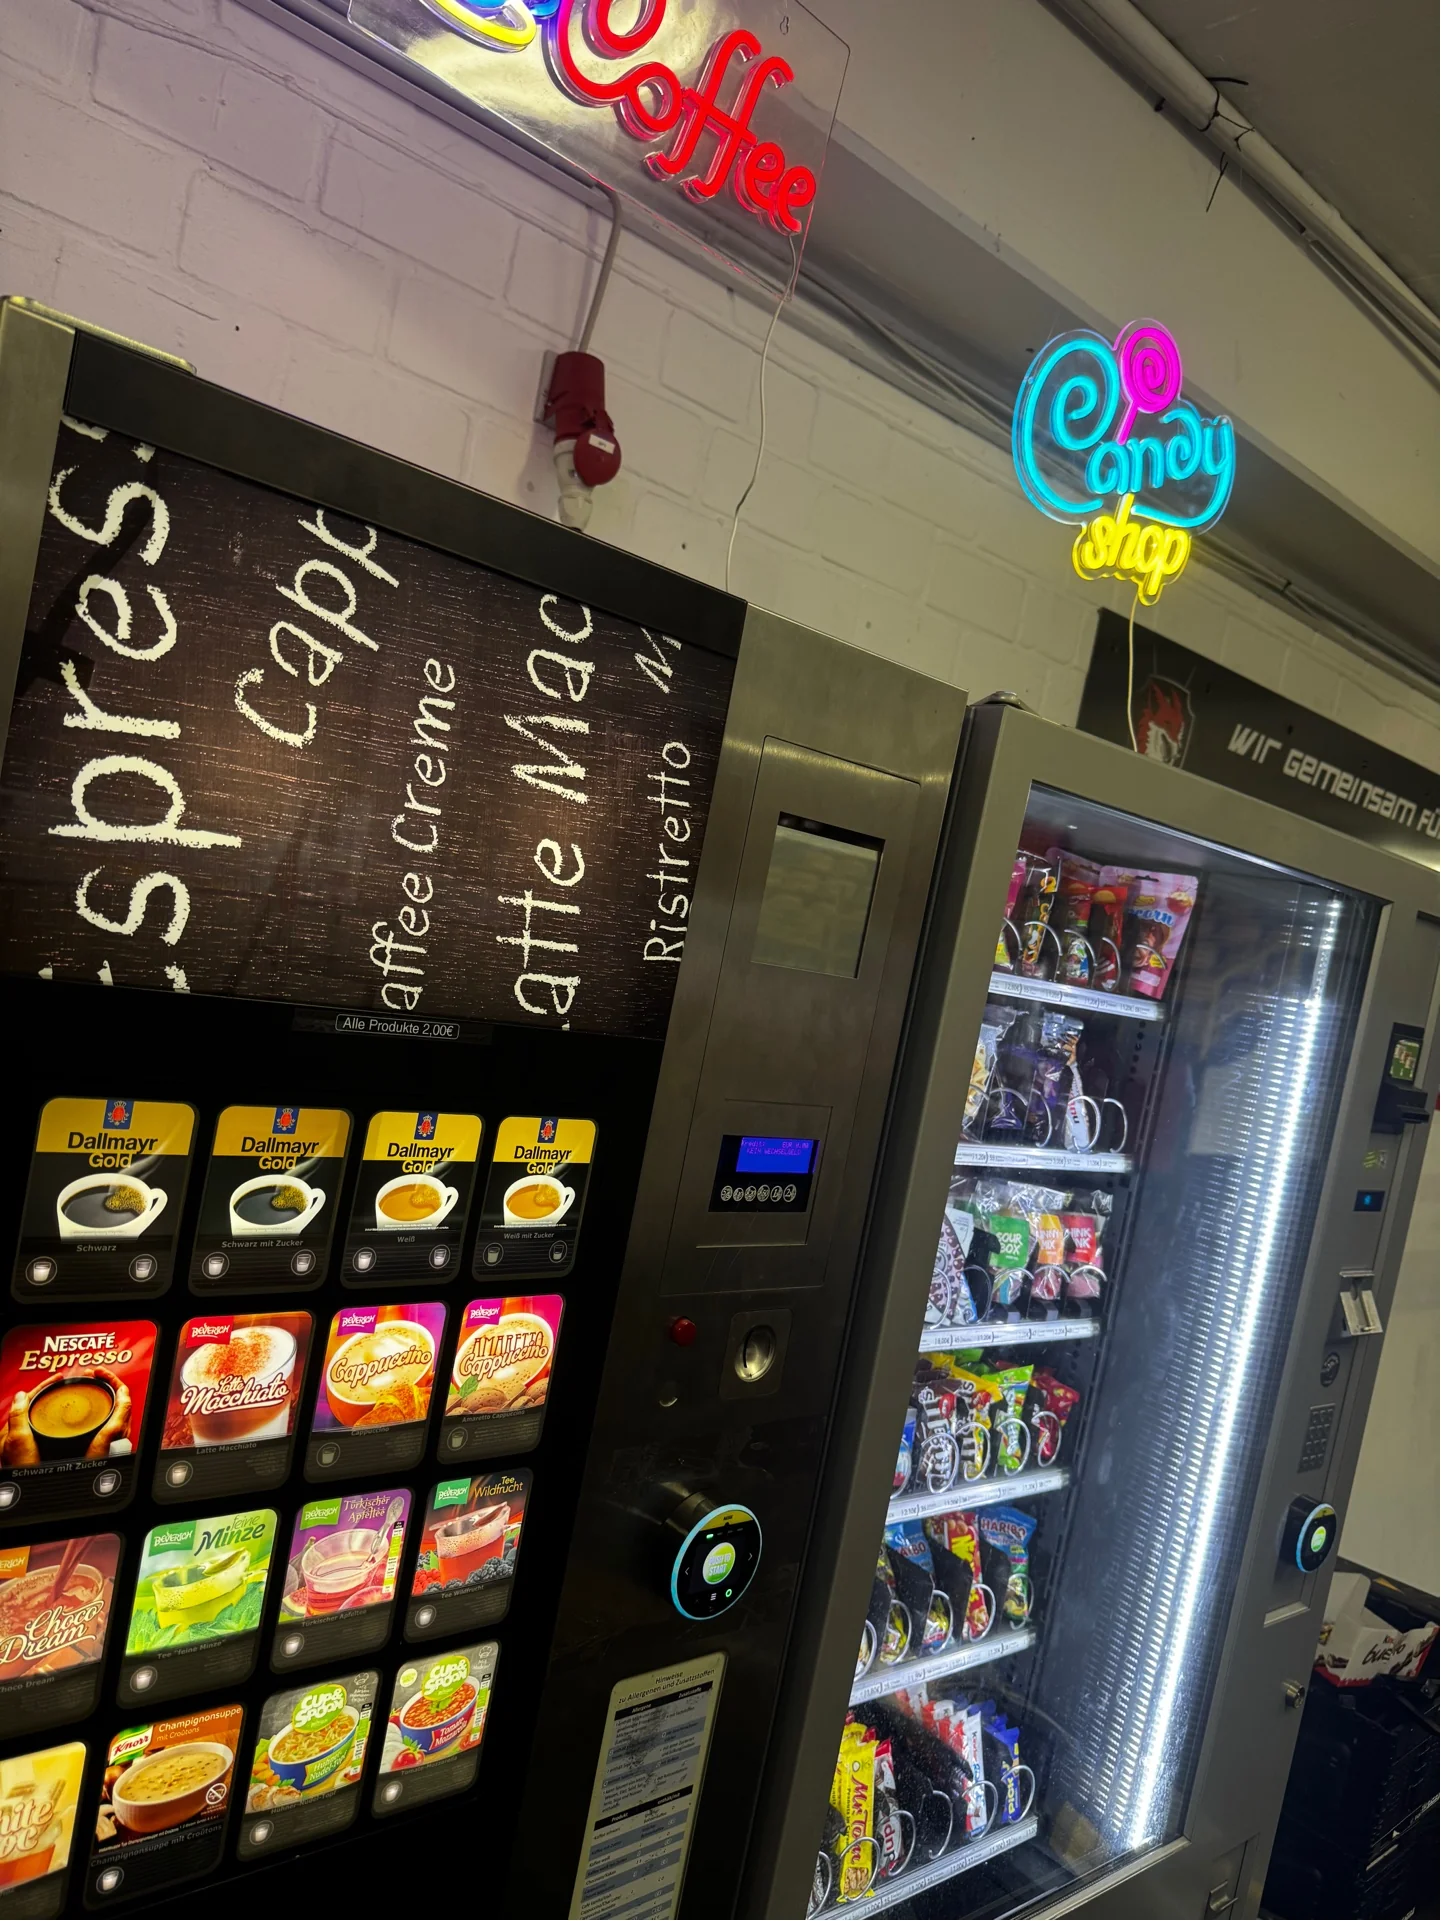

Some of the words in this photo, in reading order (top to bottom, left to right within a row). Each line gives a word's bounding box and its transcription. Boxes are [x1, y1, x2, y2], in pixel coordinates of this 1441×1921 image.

[548, 0, 816, 236] Coffee
[1022, 337, 1236, 528] Candy
[1080, 493, 1190, 596] shop
[642, 741, 692, 963] Ristretto
[342, 1017, 366, 1030] Alle
[368, 1019, 420, 1034] Produkte
[422, 1023, 455, 1037] 2,00€
[67, 1131, 159, 1153] Dallmayr
[240, 1136, 319, 1157] Dallmayr
[386, 1142, 454, 1161] Dallmayr
[88, 1152, 133, 1169] Gold
[258, 1155, 297, 1170] Gold
[513, 1145, 572, 1162] Dallmayr
[401, 1160, 436, 1173] Gold
[526, 1161, 555, 1175] Gold
[221, 1240, 258, 1249] Schwarz
[260, 1239, 274, 1248] mit
[275, 1238, 304, 1248] Zucker
[397, 1235, 416, 1243] Weiß
[503, 1232, 521, 1240] Weiß
[521, 1232, 532, 1240] mit
[533, 1231, 555, 1240] Zucker
[76, 1243, 117, 1253] Schwarz
[19, 1349, 133, 1373] Espresso
[330, 1345, 433, 1388] Cappuccino
[459, 1341, 548, 1381] Cappuccino
[180, 1373, 290, 1416] Macchiato
[215, 1375, 244, 1396] Latte
[462, 1414, 491, 1424] Amaretto
[492, 1409, 525, 1420] Cappuccino
[351, 1425, 390, 1437] Cappuccino
[196, 1447, 217, 1455] Latte
[218, 1441, 258, 1453] Macchiato
[12, 1466, 54, 1478] Schwarz
[56, 1463, 73, 1473] mit
[75, 1458, 108, 1471] Zucker
[474, 1481, 524, 1498] Wildfrucht
[501, 1476, 515, 1486] Tee
[231, 1514, 261, 1531] feine
[194, 1523, 266, 1557] Minze
[25, 1600, 104, 1640] Choco
[0, 1623, 97, 1664] Dream
[157, 1651, 173, 1660] Tee
[26, 1675, 55, 1688] Dream
[423, 1670, 467, 1696] SPOON
[662, 1681, 675, 1691] und
[158, 1707, 242, 1733] Champignonsuppe
[294, 1698, 344, 1728] SPOON
[112, 1733, 150, 1756] Knorr
[156, 1732, 169, 1742] mit
[90, 1841, 169, 1868] Champignonsuppe
[170, 1834, 185, 1845] mit
